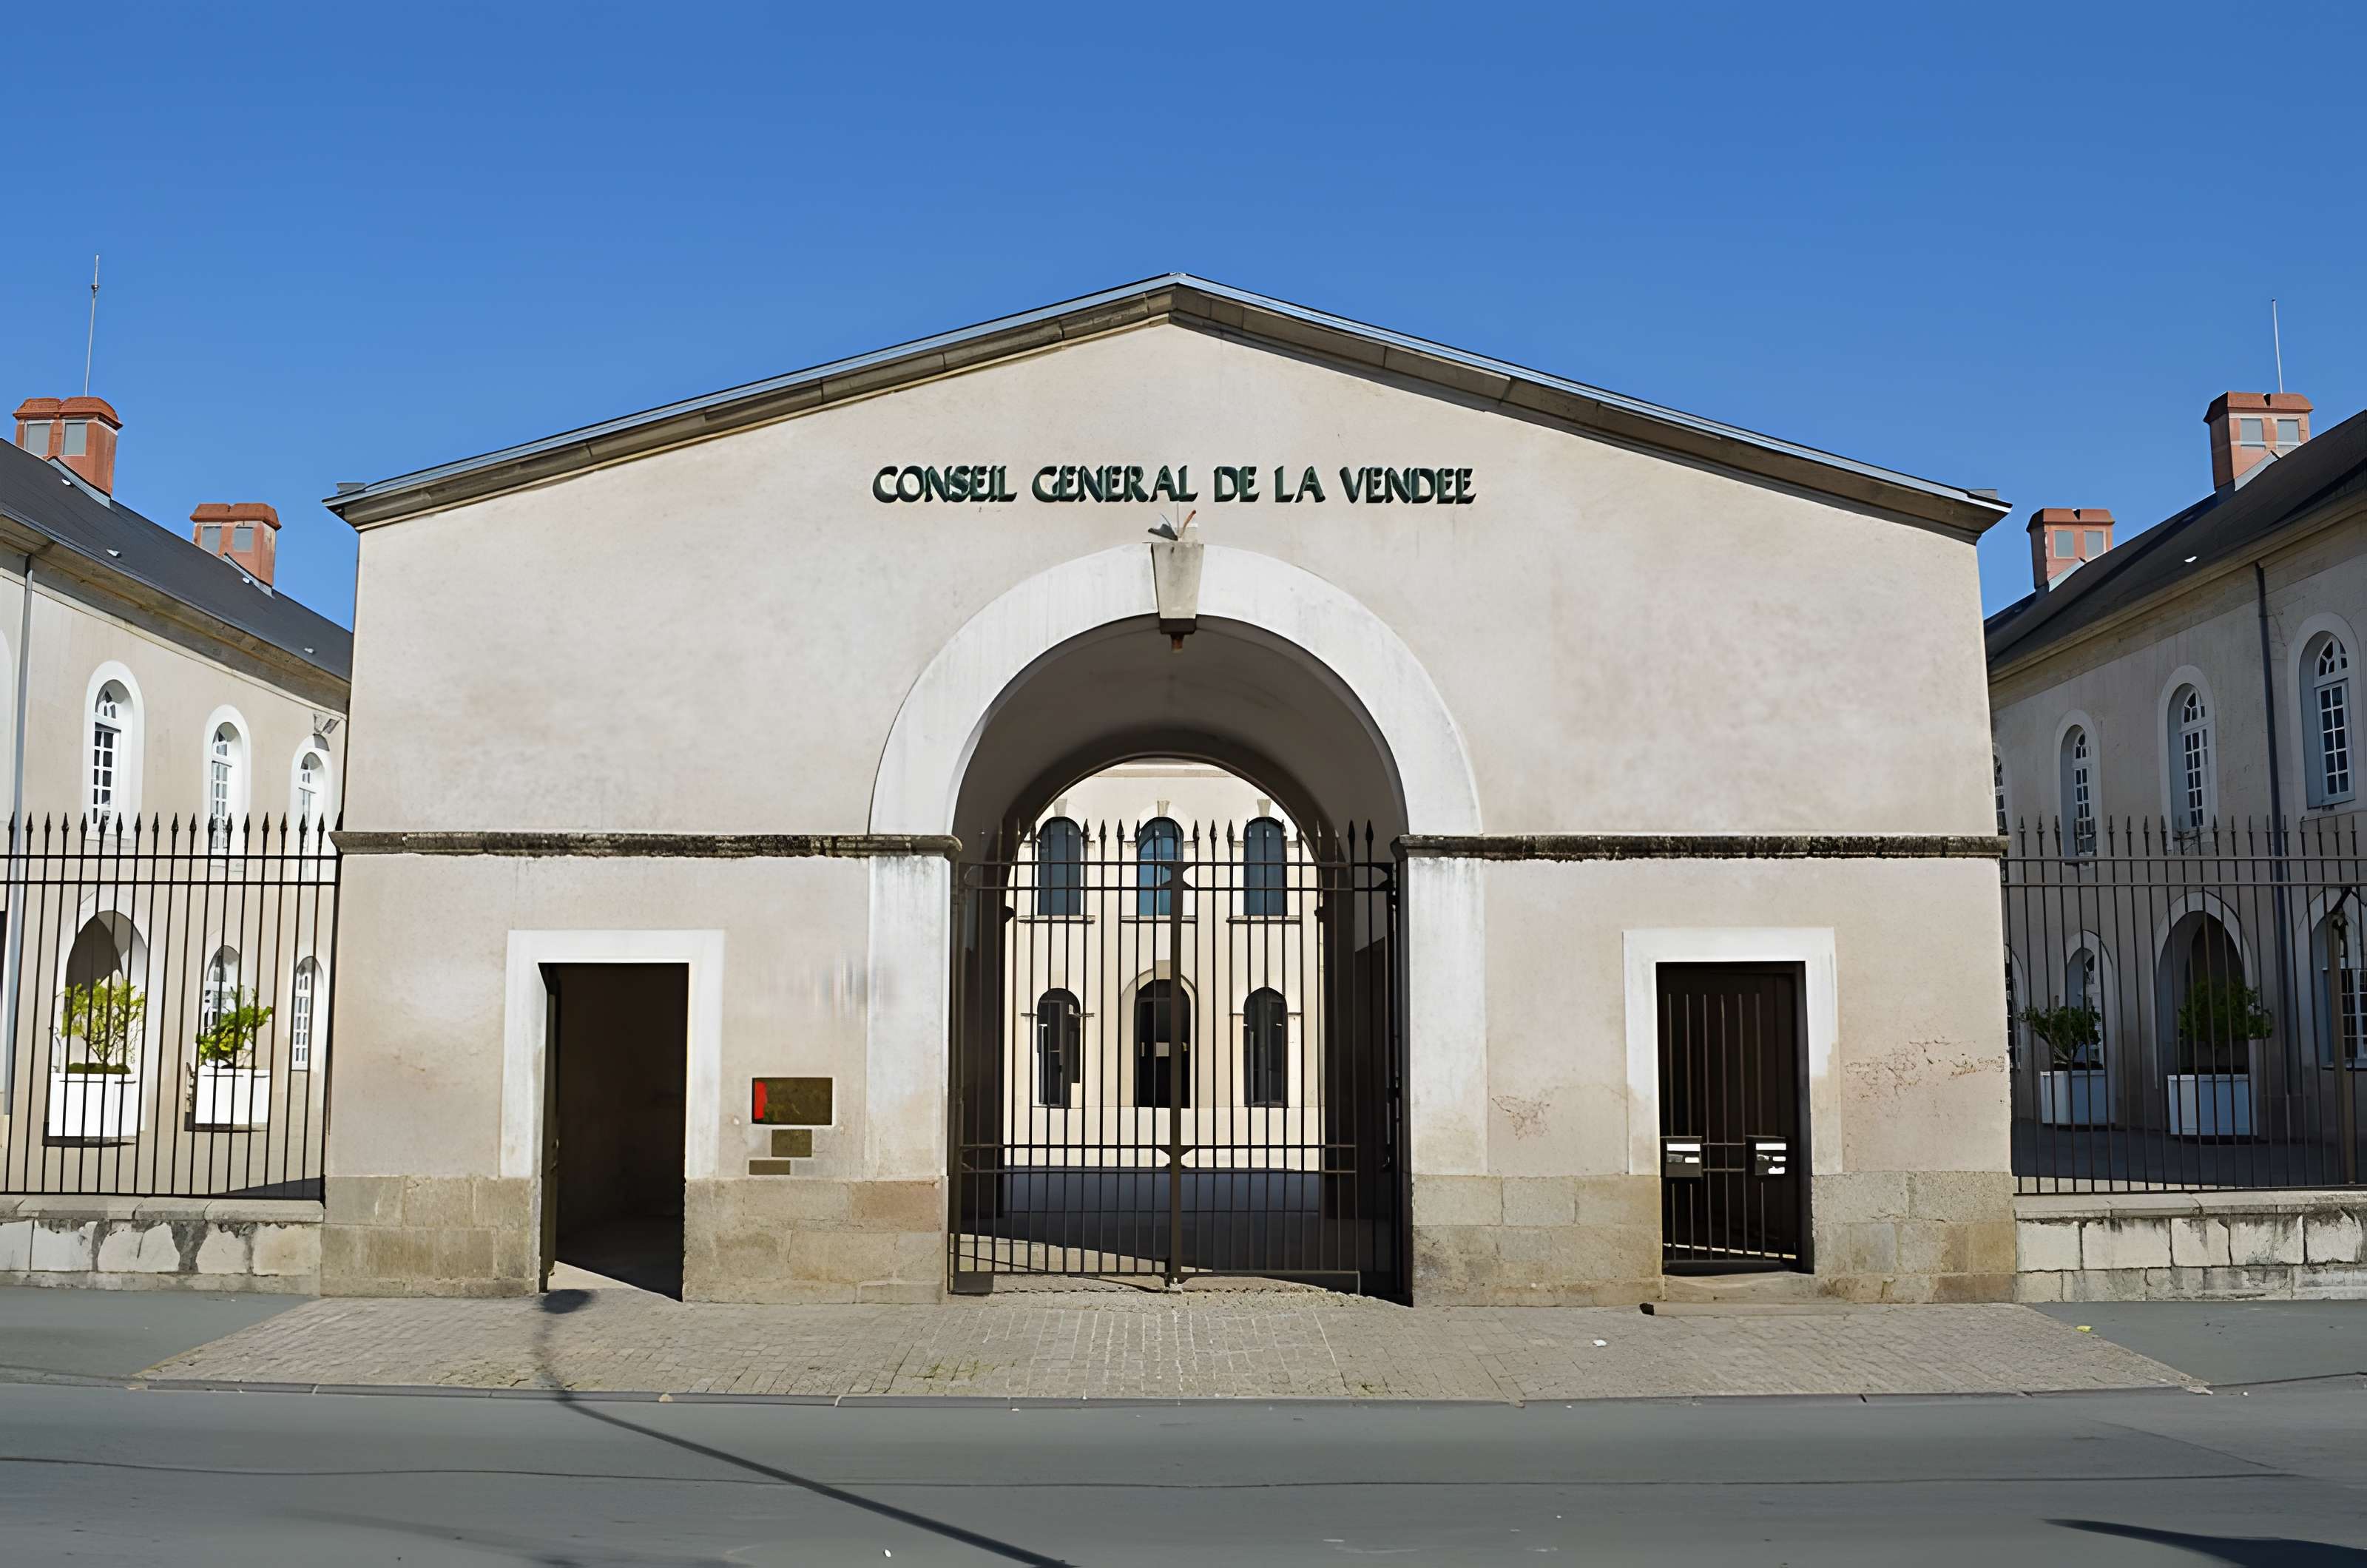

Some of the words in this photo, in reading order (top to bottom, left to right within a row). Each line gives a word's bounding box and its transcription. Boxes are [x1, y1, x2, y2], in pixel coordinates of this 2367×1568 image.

[873, 465, 1017, 503] CONSEIL
[1032, 465, 1198, 503] GENERAL
[1214, 466, 1260, 503] DE
[1274, 466, 1326, 503] LA
[1340, 467, 1476, 504] VENDEE
